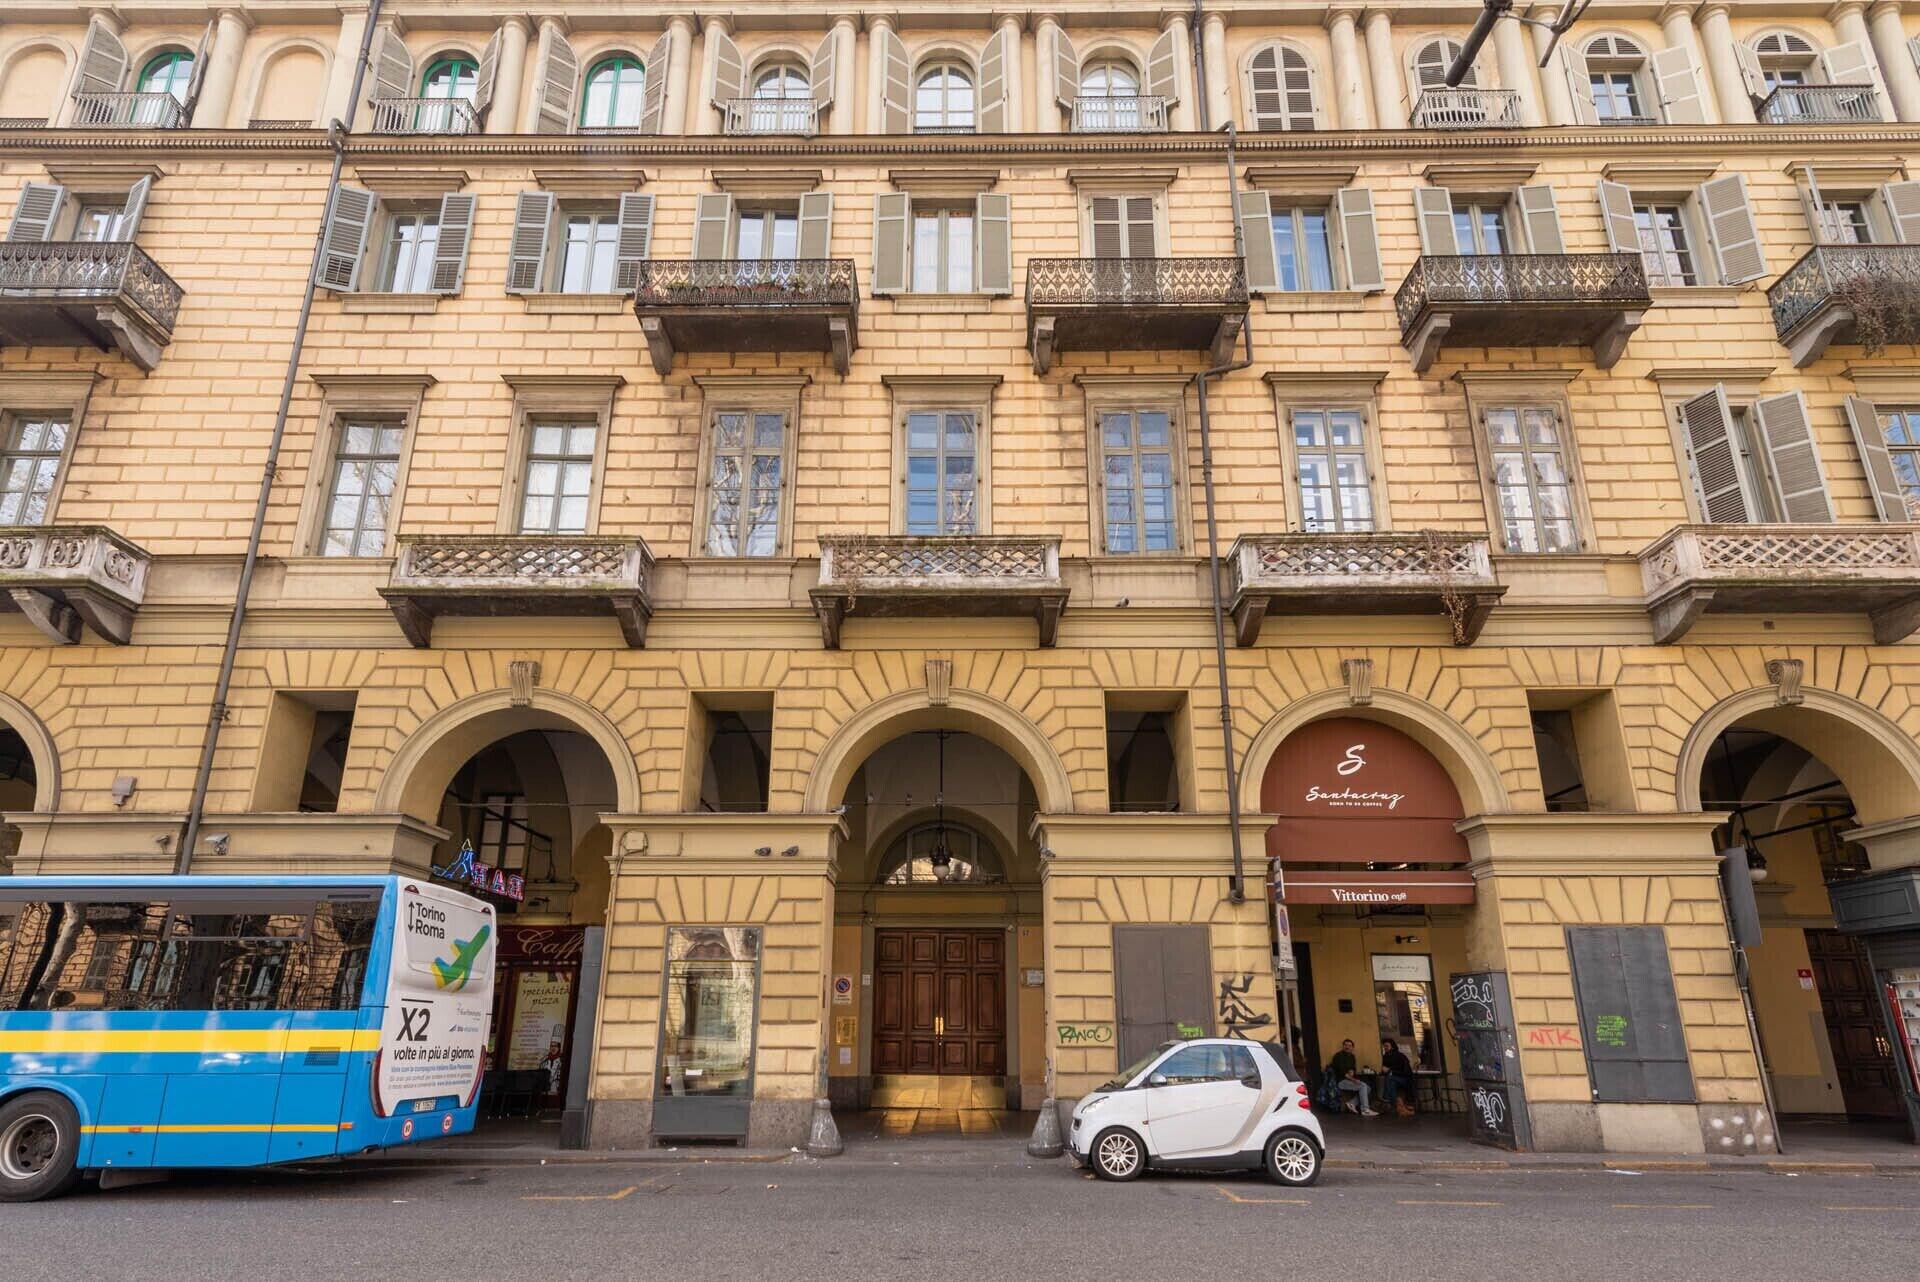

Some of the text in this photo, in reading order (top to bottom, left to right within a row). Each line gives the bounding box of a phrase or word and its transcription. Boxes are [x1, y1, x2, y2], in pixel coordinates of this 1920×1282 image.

[1305, 786, 1405, 810] Santacruz
[1331, 888, 1389, 902] Vittorino
[416, 903, 446, 922] Torino
[415, 919, 446, 939] Roma
[517, 929, 584, 959] Caff
[396, 1007, 431, 1042] X2
[394, 1046, 417, 1060] volte
[419, 1046, 427, 1059] in
[428, 1046, 441, 1062] più
[443, 1046, 450, 1060] al
